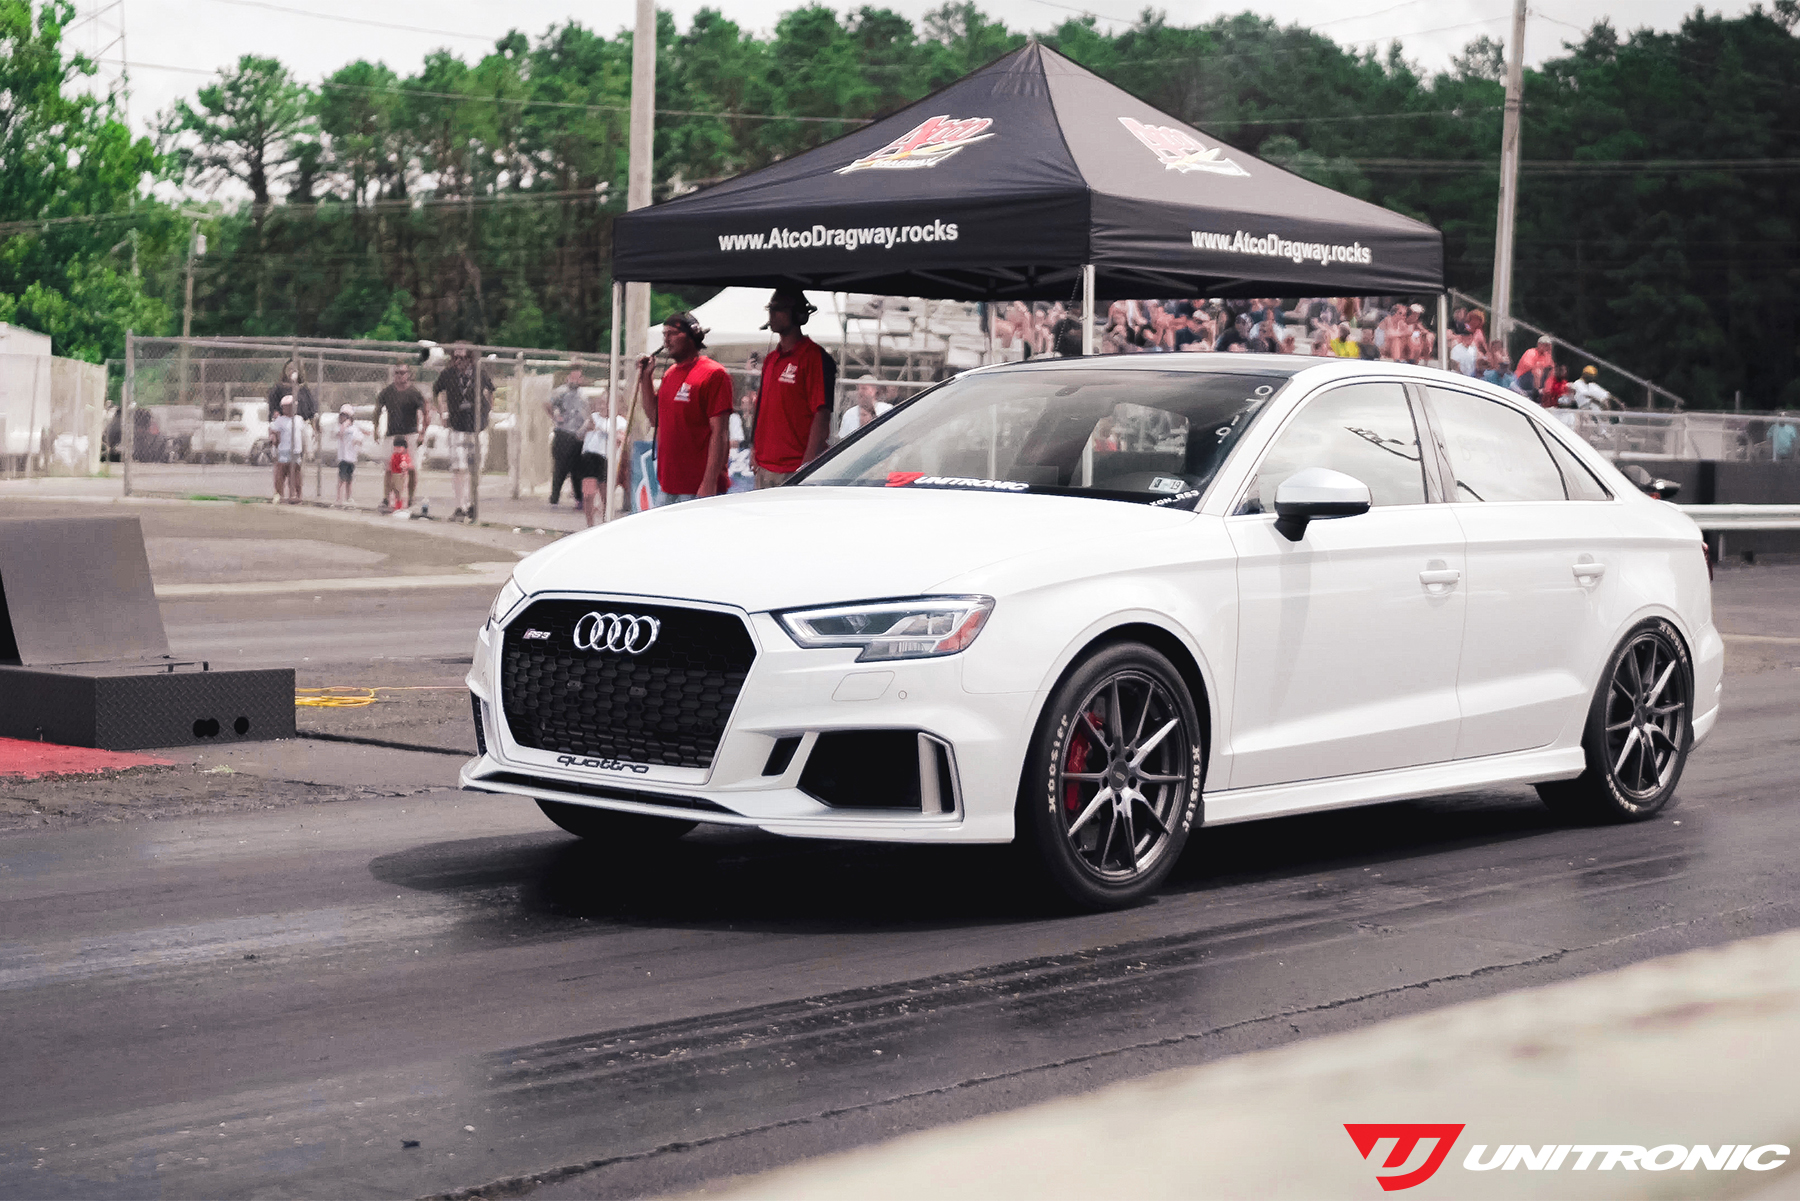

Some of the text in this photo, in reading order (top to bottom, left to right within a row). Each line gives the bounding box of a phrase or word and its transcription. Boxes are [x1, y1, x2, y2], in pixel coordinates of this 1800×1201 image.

[850, 114, 994, 162] Atco
[718, 219, 958, 250] www.AtcoDragway.rocks
[1191, 230, 1372, 266] www.AtcoDragway.rocks
[914, 476, 1030, 491] UNITRONIC
[556, 754, 650, 774] quattro
